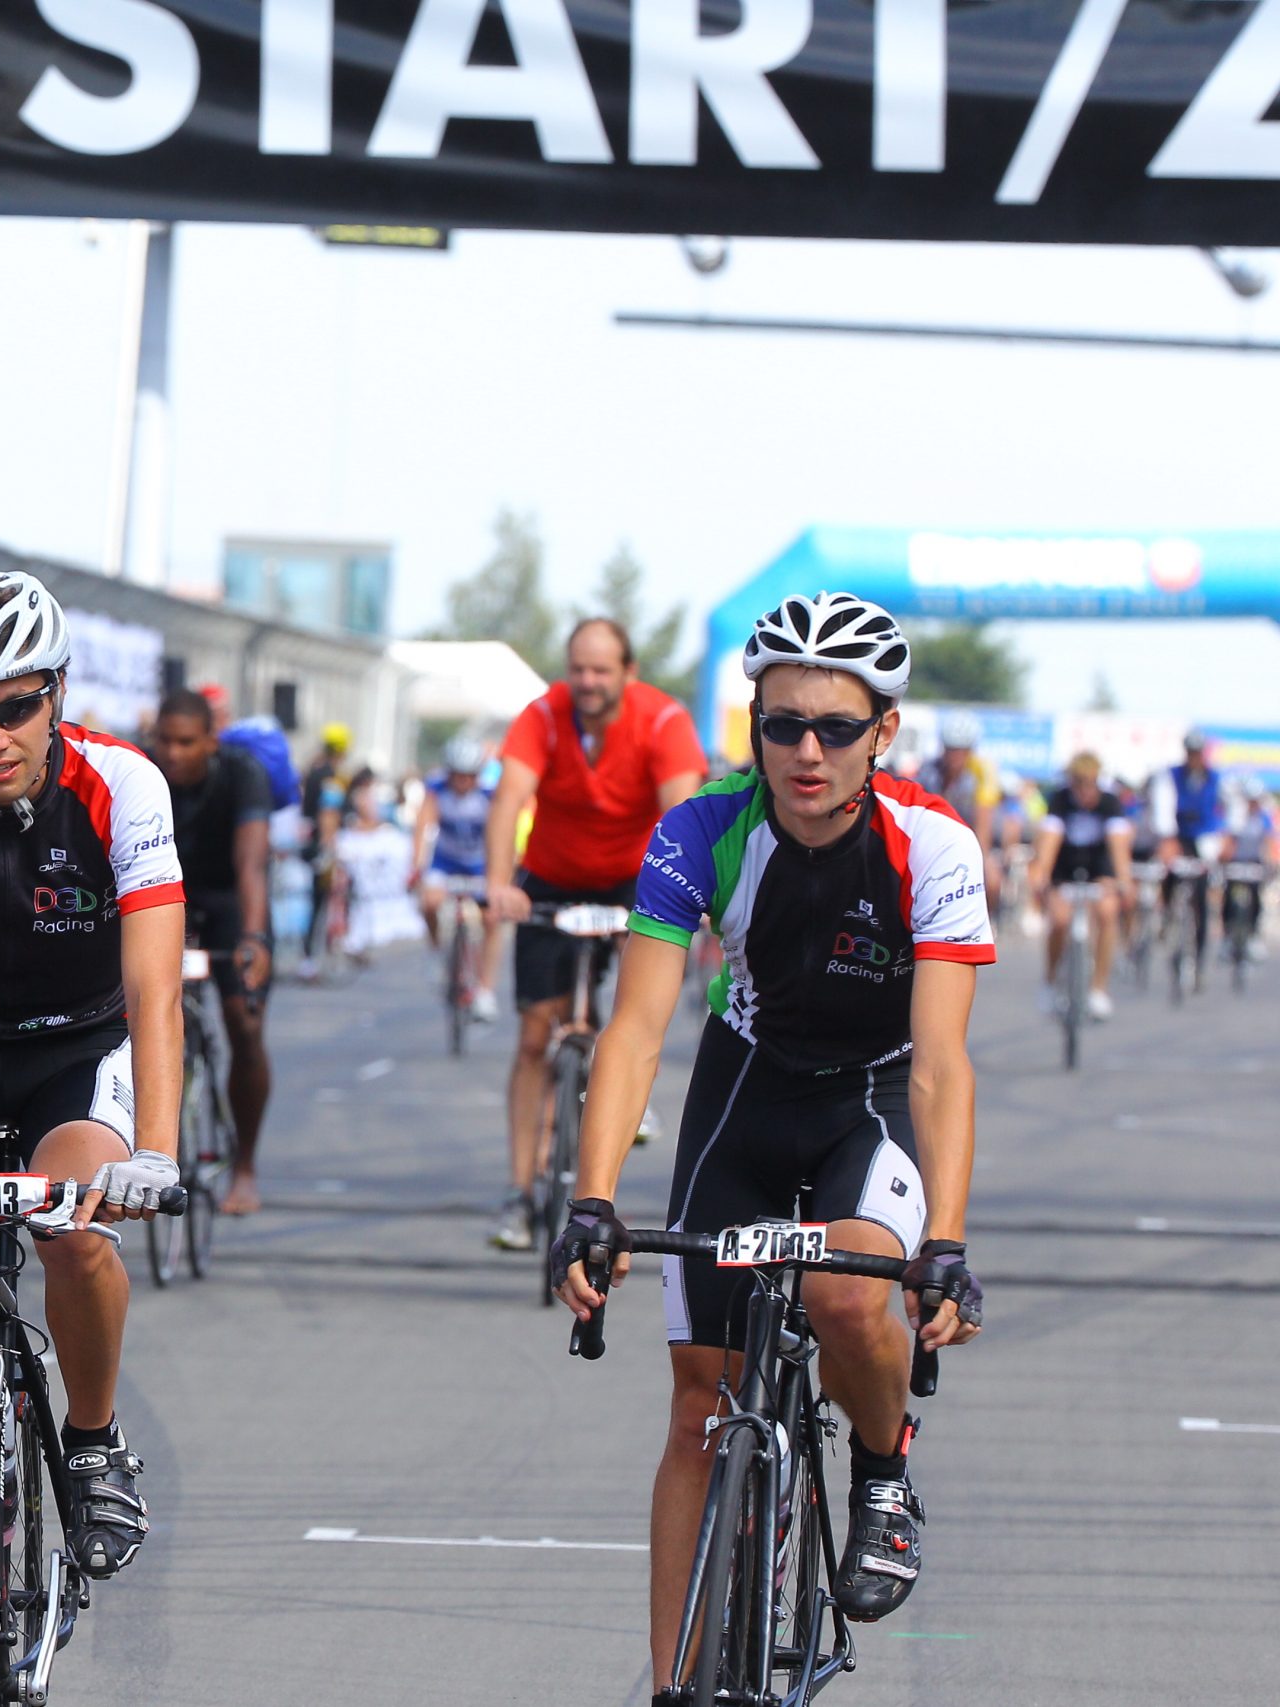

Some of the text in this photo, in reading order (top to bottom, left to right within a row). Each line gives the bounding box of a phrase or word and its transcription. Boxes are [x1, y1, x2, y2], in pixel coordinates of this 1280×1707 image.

[5, 664, 35, 679] uvex
[133, 836, 160, 853] rad
[34, 887, 97, 914] DGD
[937, 885, 966, 906] rad
[32, 917, 95, 934] Racing
[832, 932, 891, 966] DGD
[826, 959, 884, 983] Racing
[721, 1230, 823, 1262] A-2003
[72, 1456, 102, 1467] NW
[870, 1486, 905, 1503] SIDI
